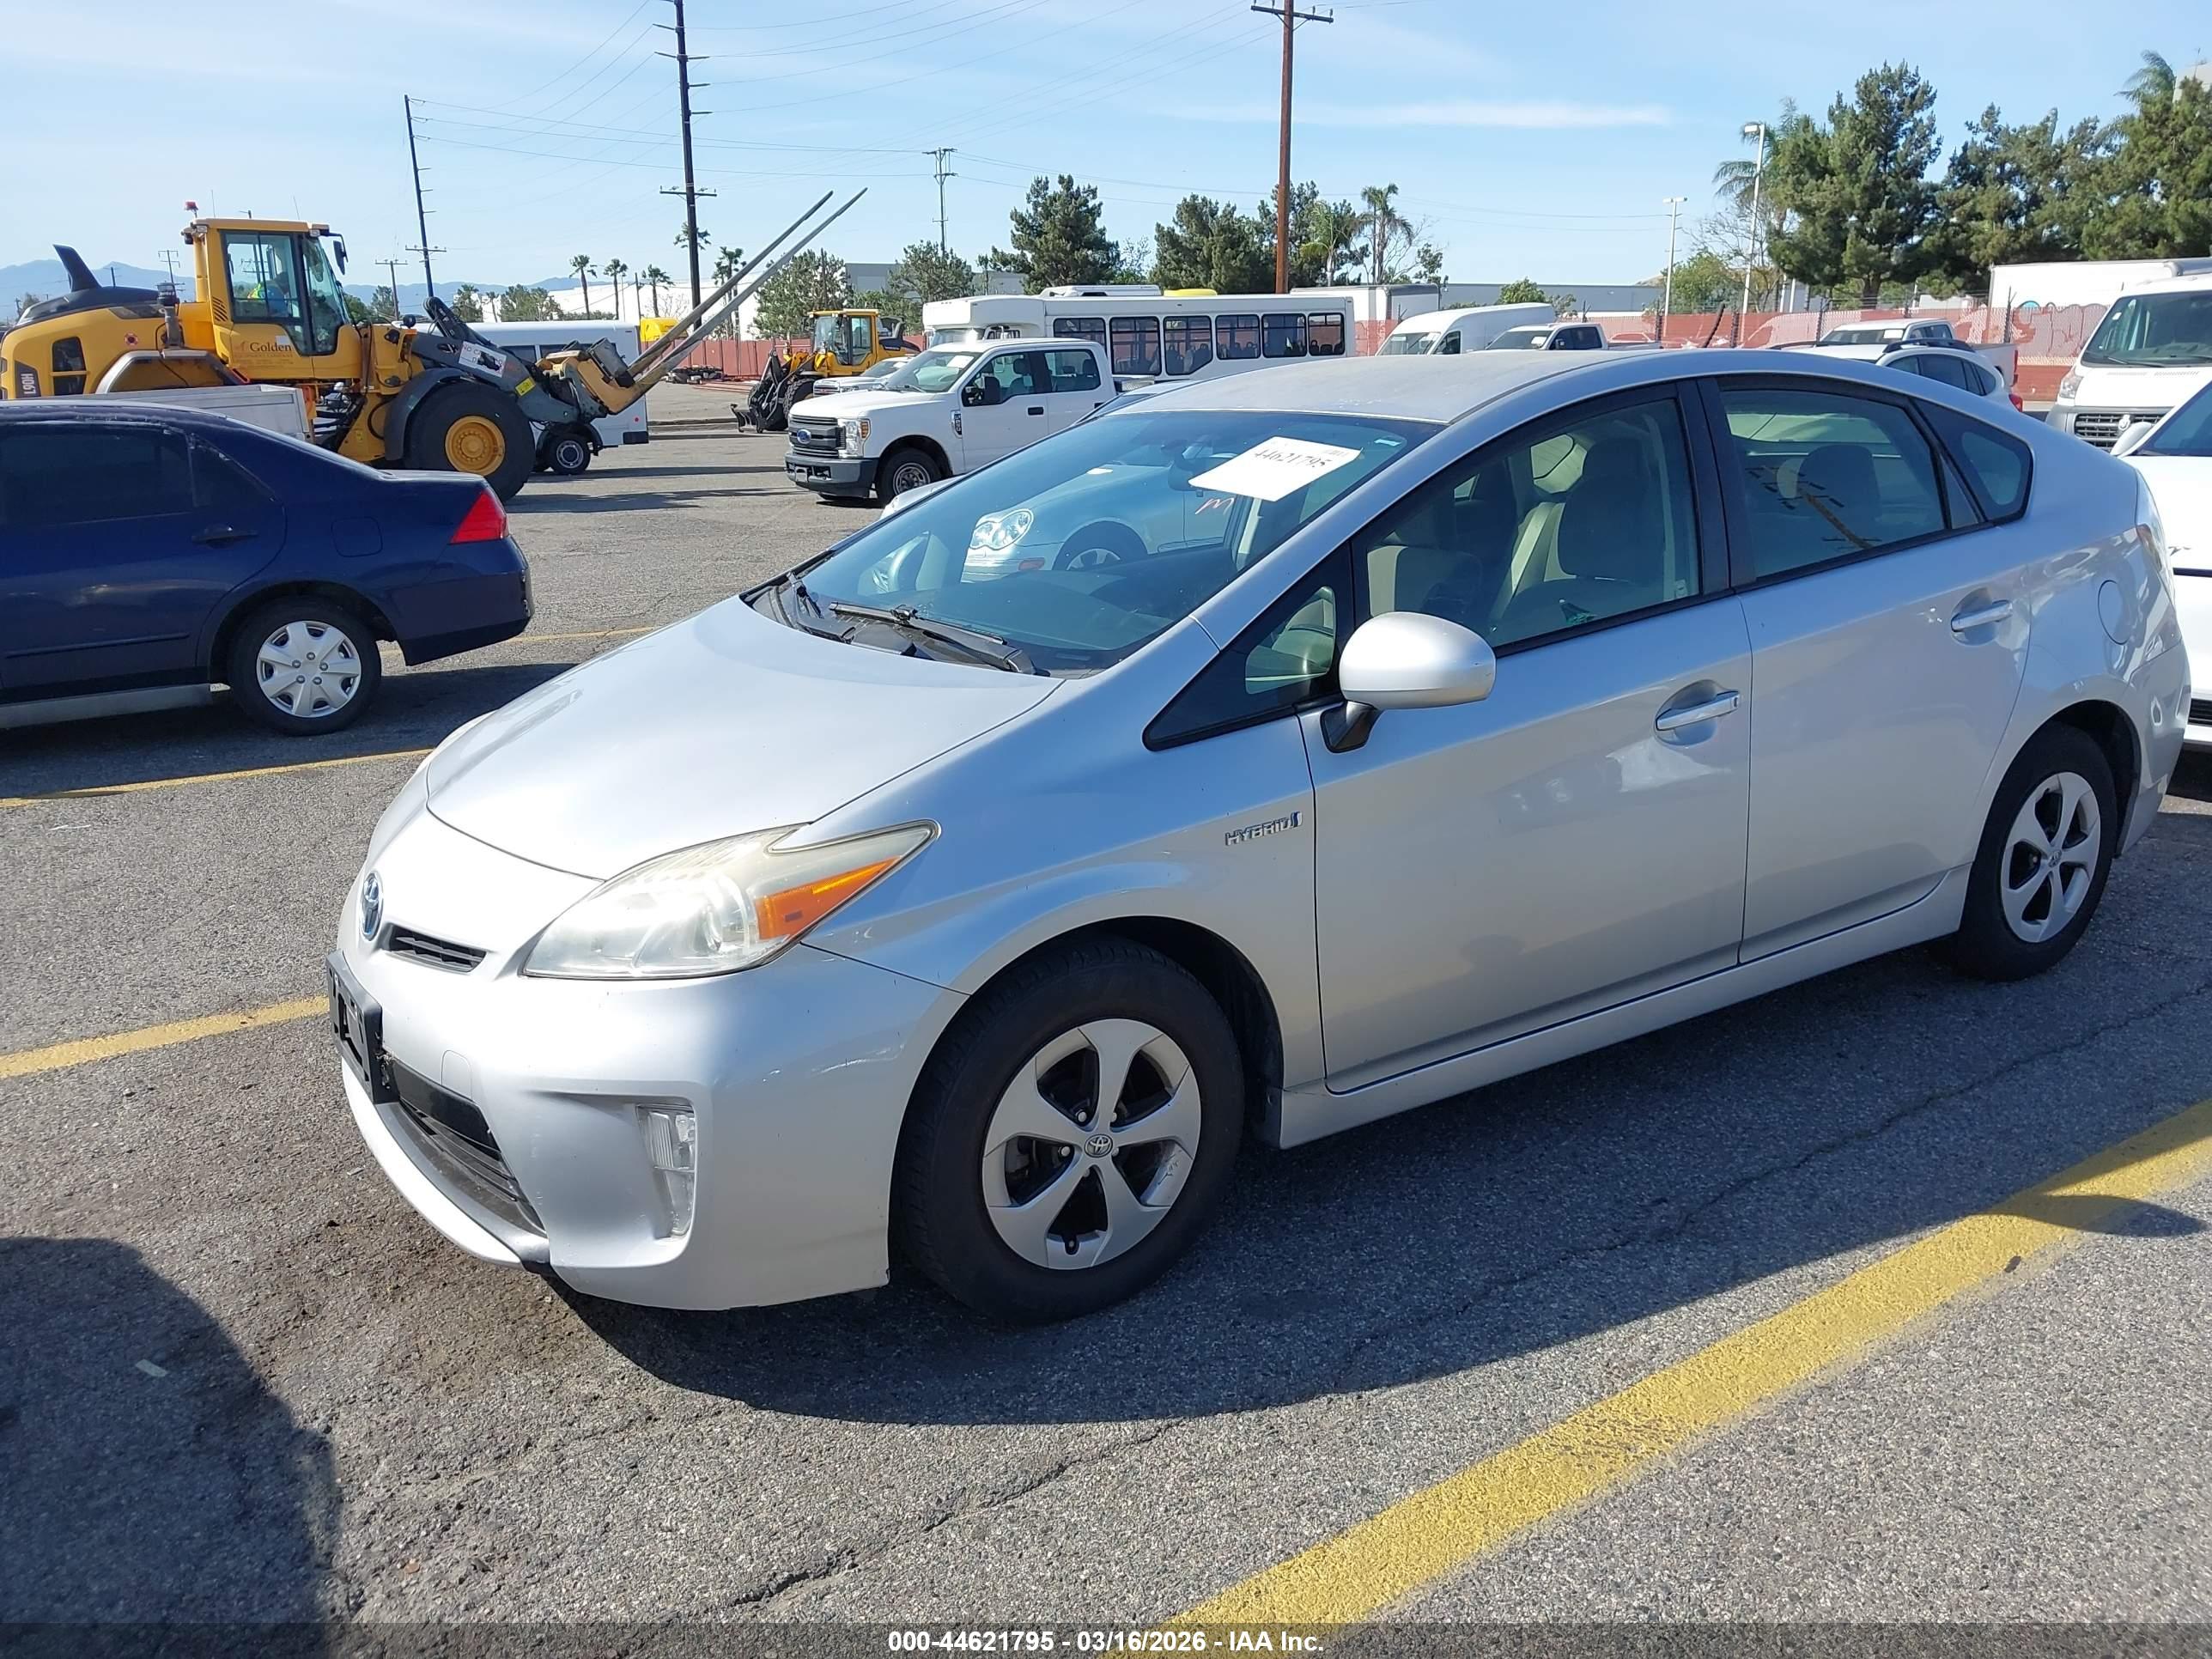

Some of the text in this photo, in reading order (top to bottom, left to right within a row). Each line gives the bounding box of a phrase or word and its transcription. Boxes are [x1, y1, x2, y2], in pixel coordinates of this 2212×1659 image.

[250, 342, 292, 352] Golden
[21, 373, 36, 394] L90H
[1225, 817, 1291, 846] HYBRID
